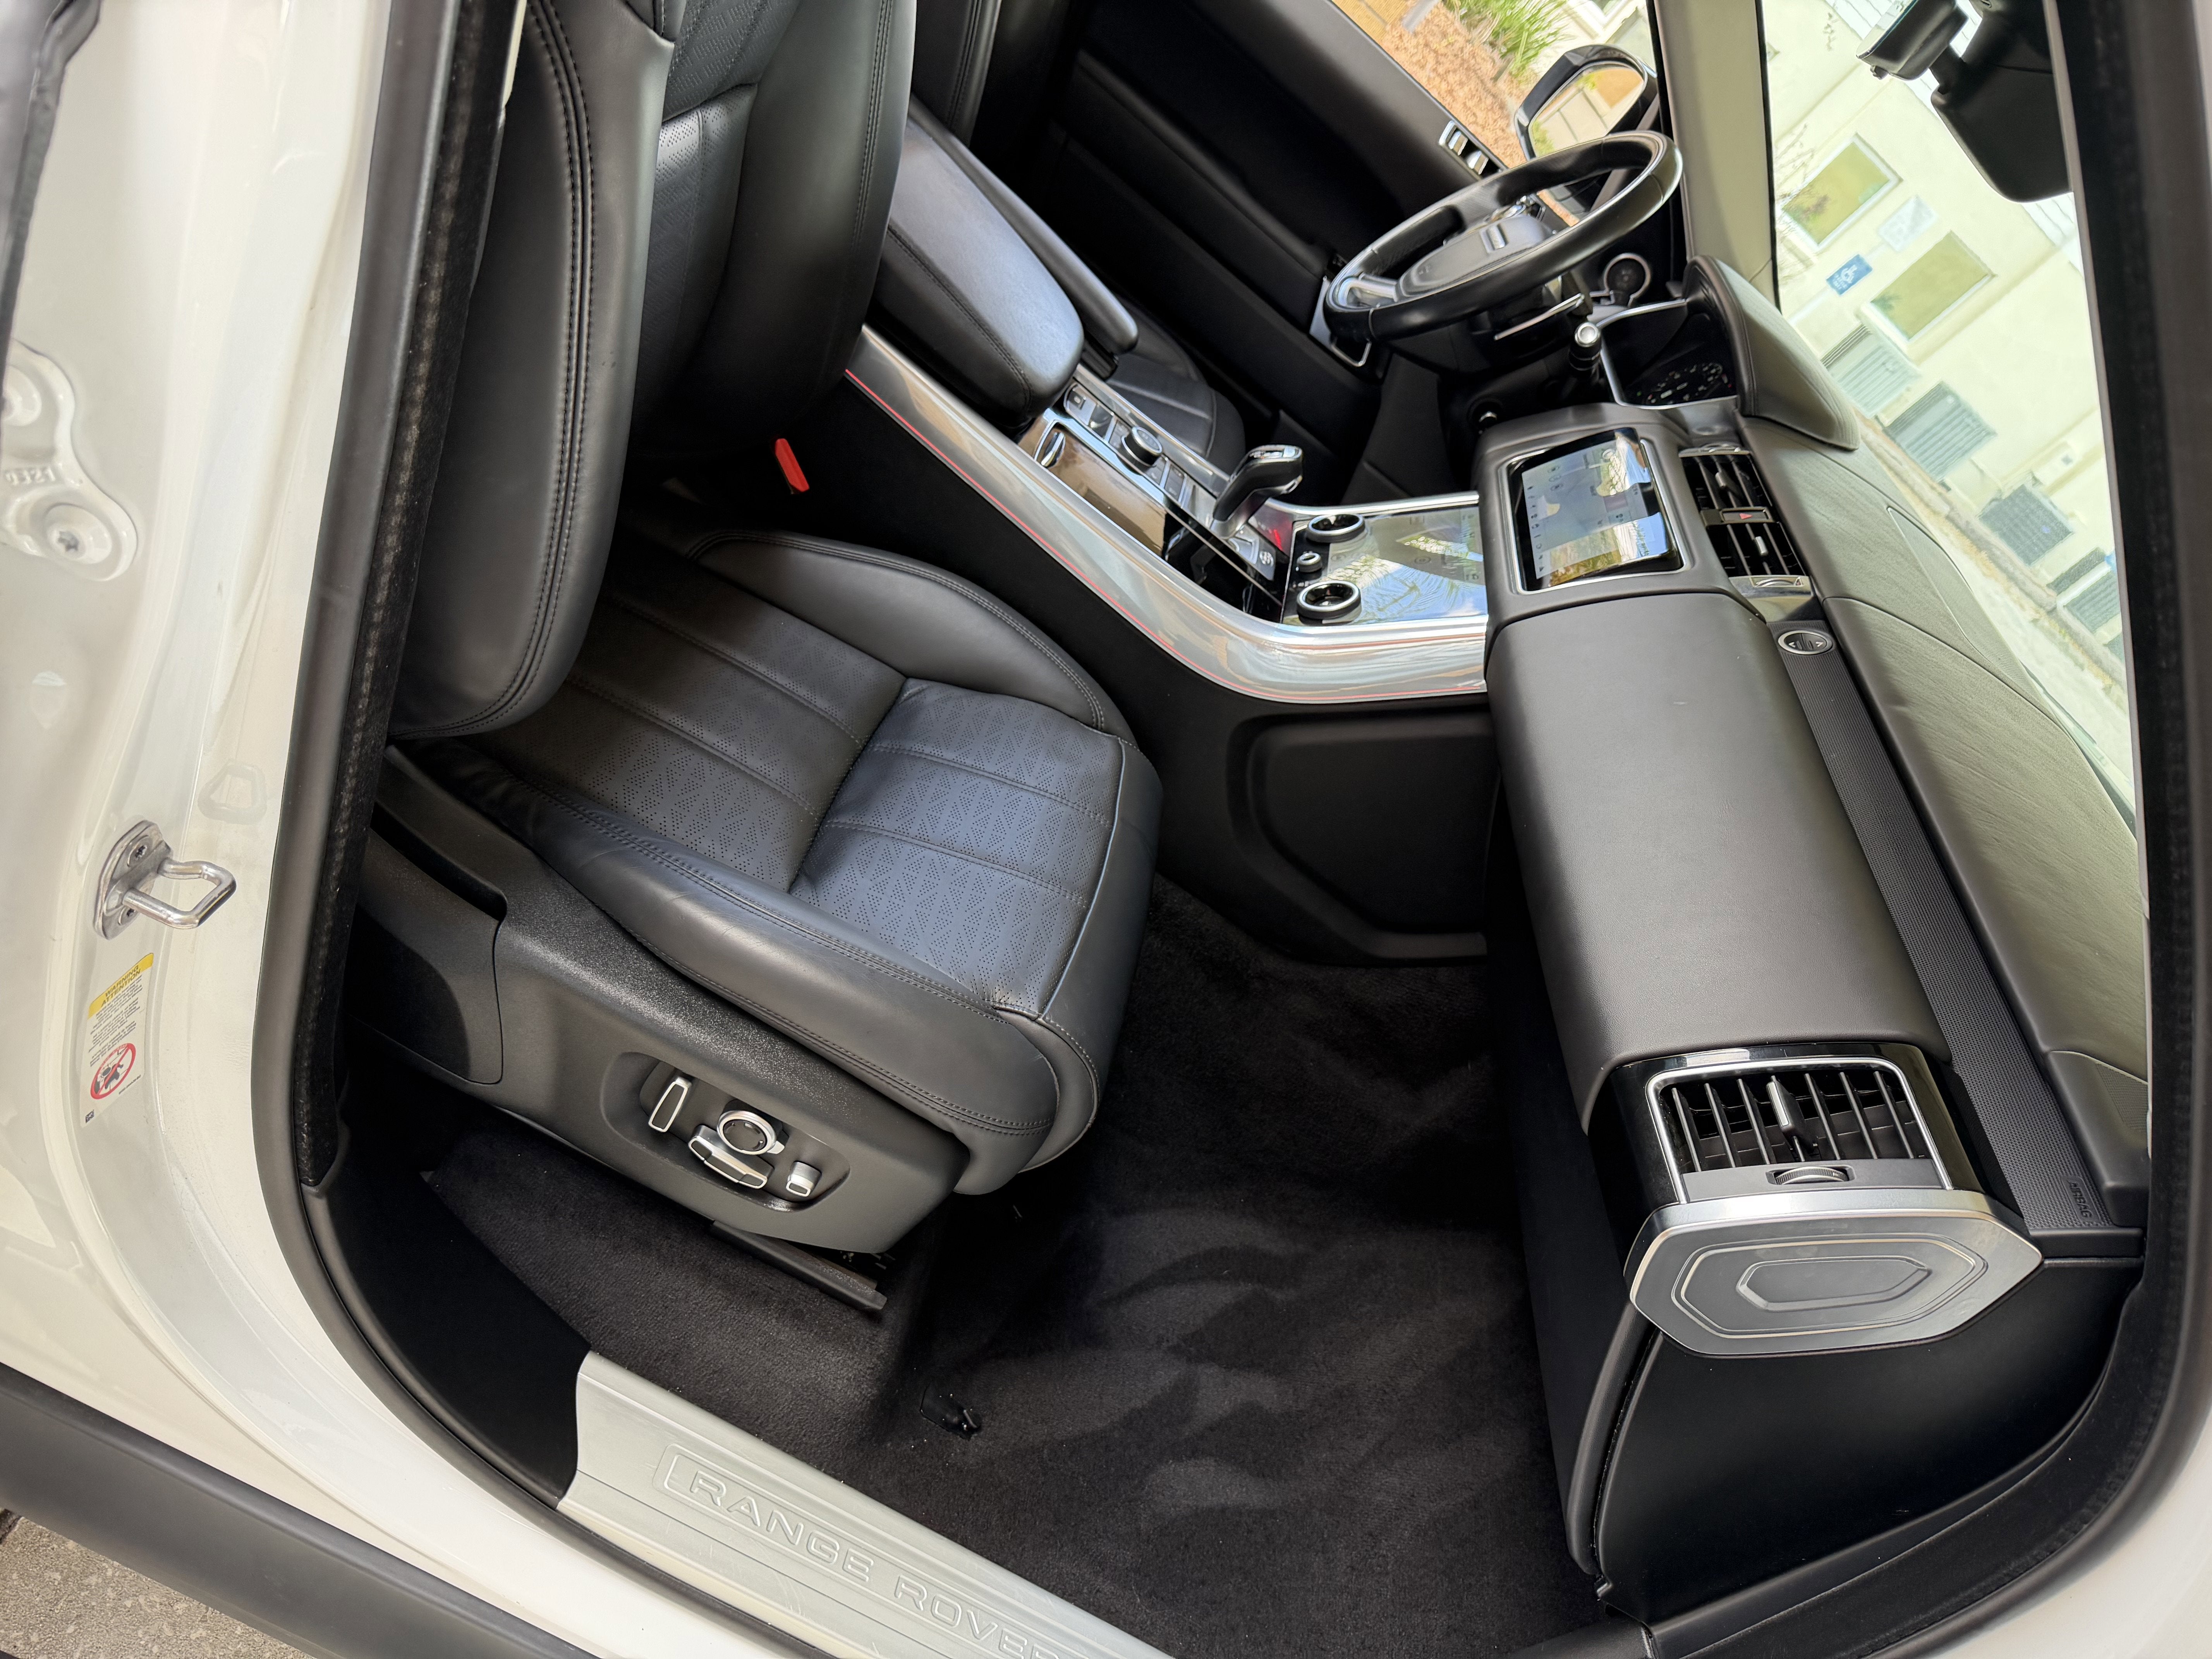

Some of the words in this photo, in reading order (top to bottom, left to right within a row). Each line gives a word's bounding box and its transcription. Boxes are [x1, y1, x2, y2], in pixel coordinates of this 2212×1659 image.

[101, 968, 141, 1007] ATTENTION
[105, 965, 139, 997] WARNING
[2068, 1181, 2093, 1218] AIRBAG
[690, 1470, 874, 1582] RANGE
